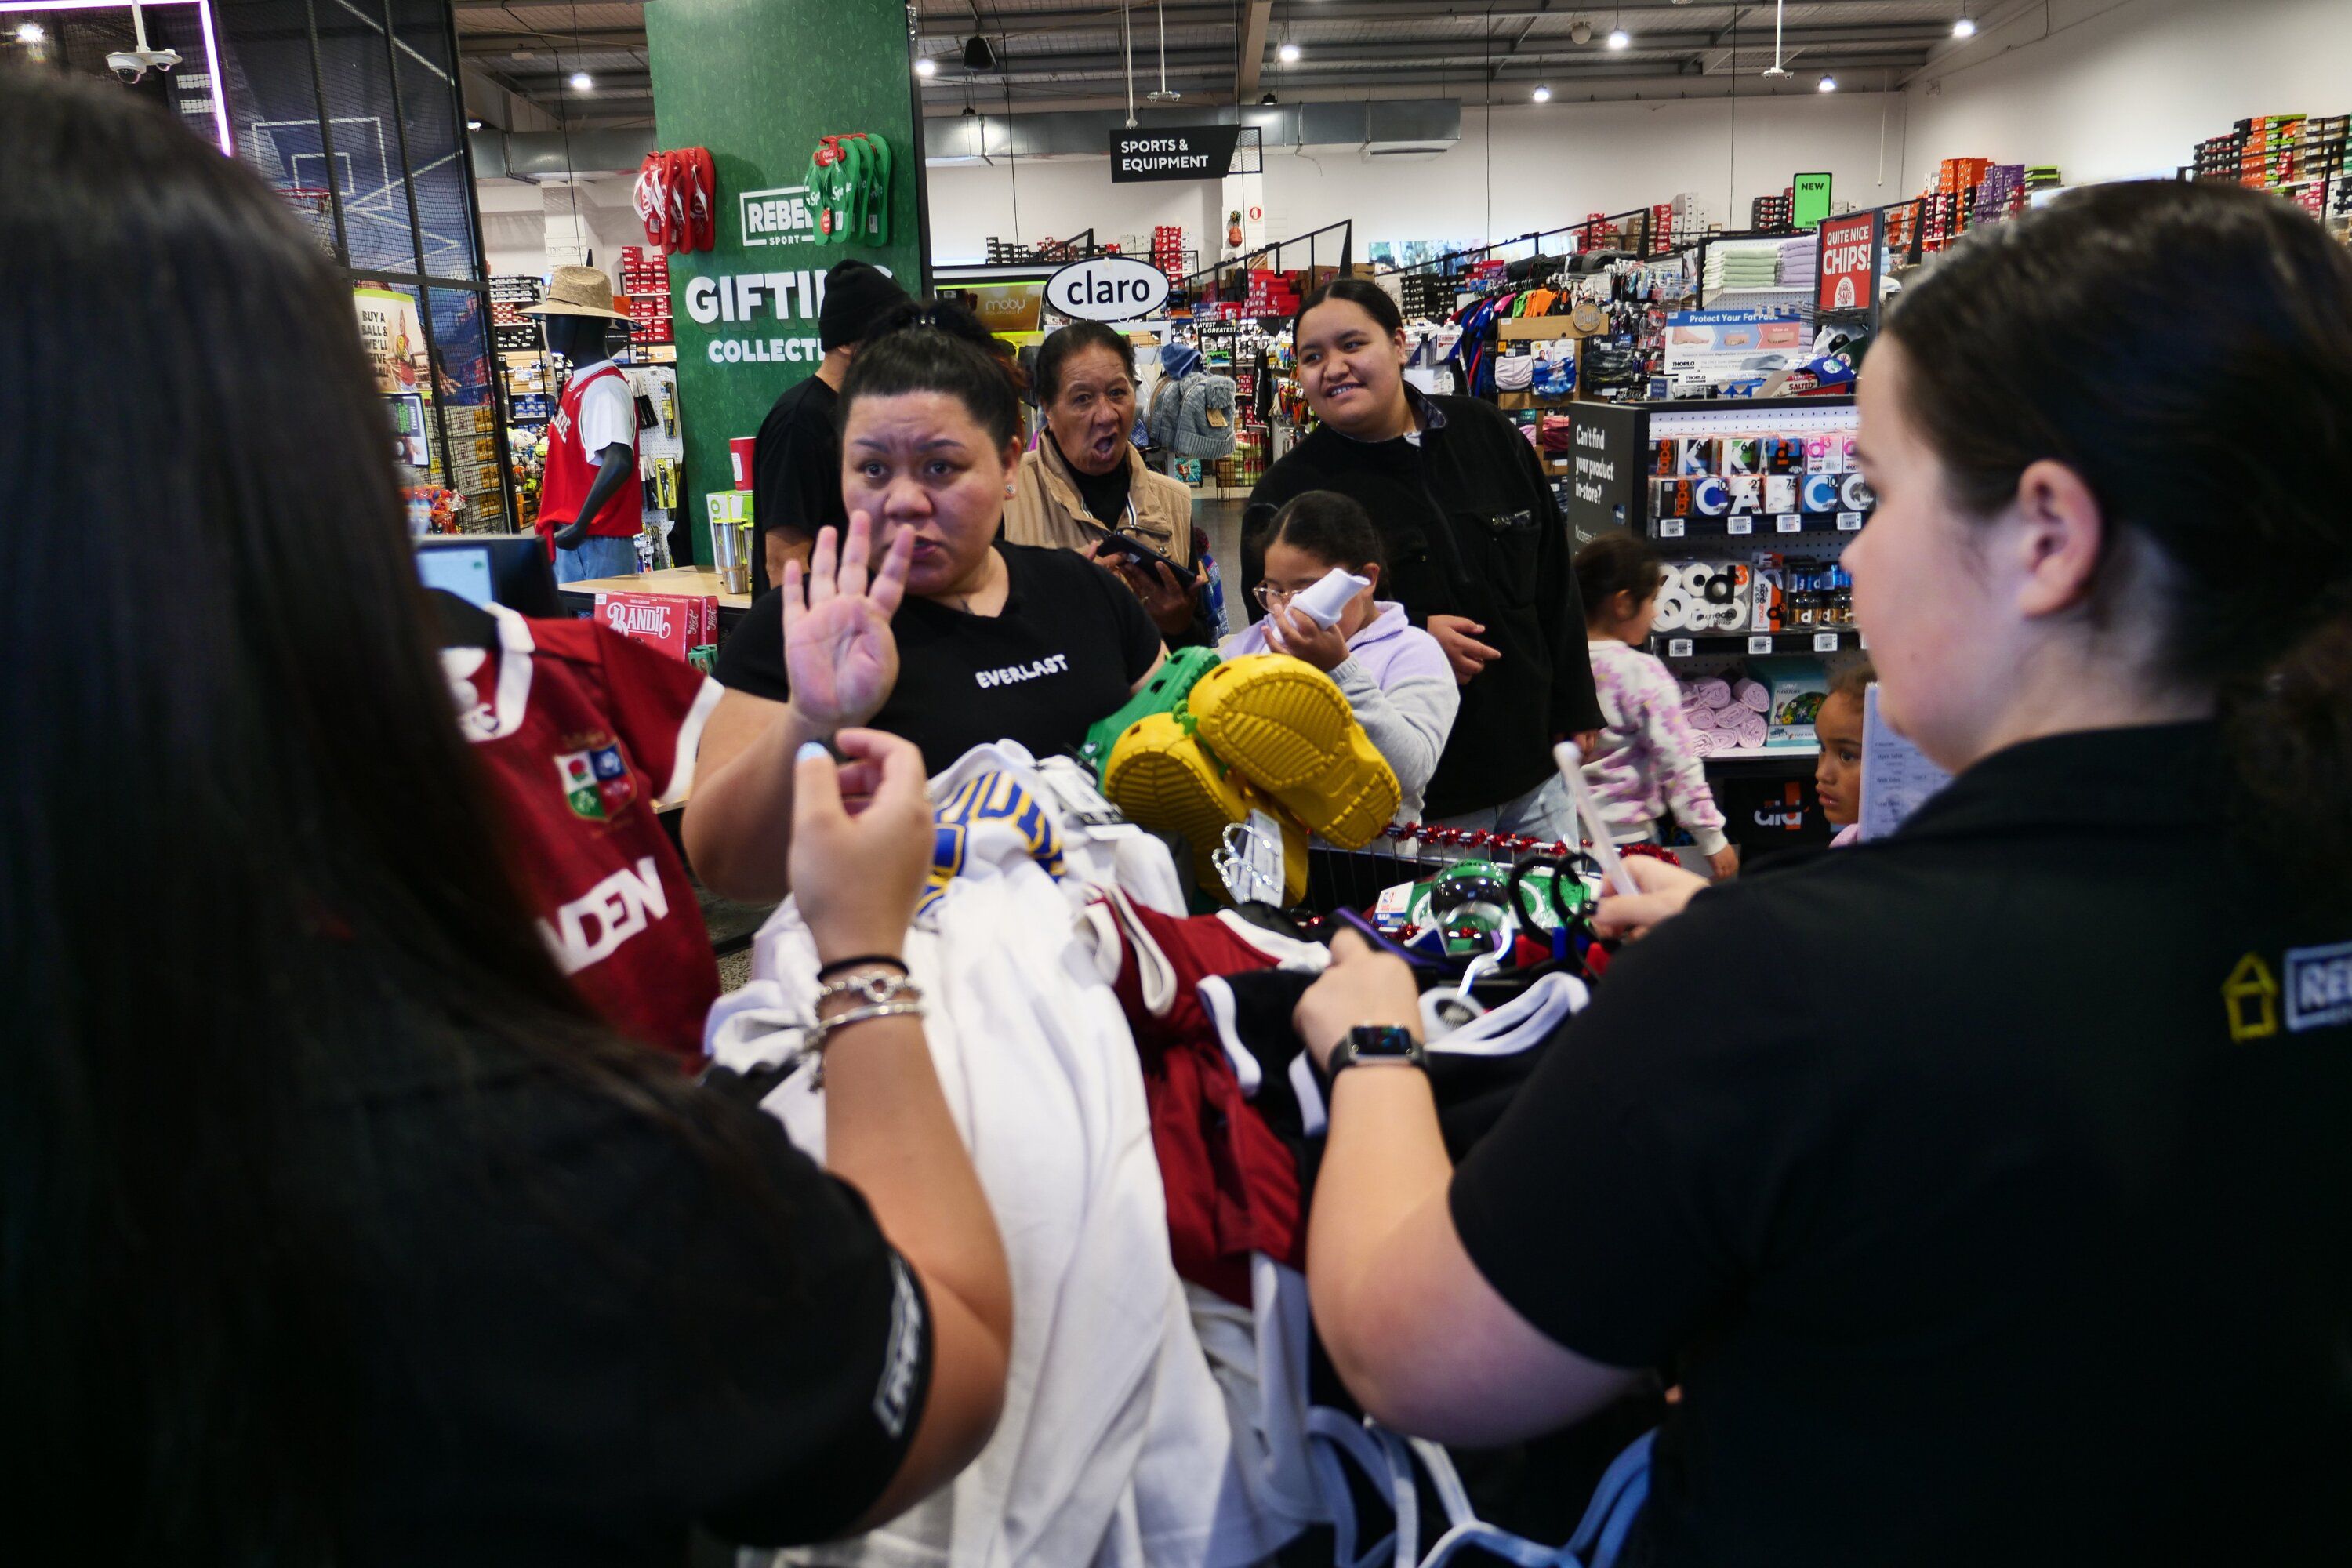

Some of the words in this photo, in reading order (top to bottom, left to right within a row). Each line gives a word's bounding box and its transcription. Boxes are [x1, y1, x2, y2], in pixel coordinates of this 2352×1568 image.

[1120, 140, 1177, 154] SPORTS
[1178, 139, 1189, 151] &
[1122, 155, 1209, 172] EQUIPMENT
[768, 235, 800, 246] SPORT
[1827, 229, 1849, 246] QUITE
[1851, 225, 1869, 242] NICE
[1823, 243, 1872, 276] CHIPS!
[1066, 270, 1151, 305] claro
[362, 310, 378, 322] BUY
[380, 312, 386, 323] A
[985, 298, 1025, 314] moby
[1690, 314, 1720, 323] Protect
[361, 325, 382, 336] BALL
[383, 327, 388, 336] &
[363, 339, 388, 350] WE'LL
[708, 338, 826, 363] COLLECTI
[1576, 424, 1592, 447] Can't
[1592, 427, 1605, 450] find
[1576, 456, 1588, 475] your
[1589, 457, 1613, 481] product
[1575, 477, 1602, 505] in-store?
[975, 654, 1068, 688] EVERLAST
[2300, 958, 2352, 1011] RE
